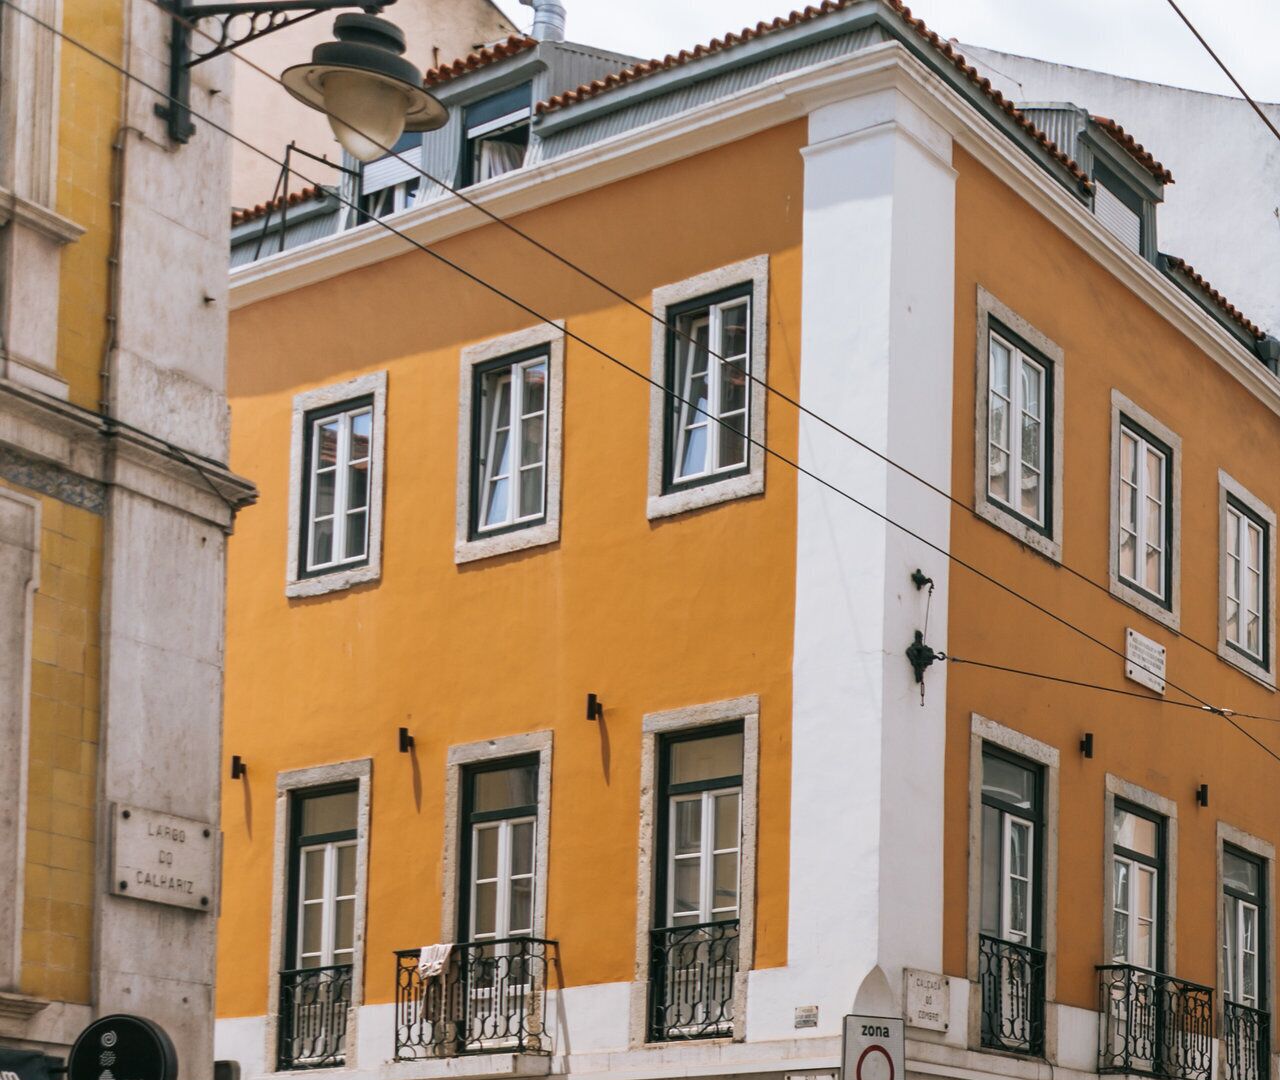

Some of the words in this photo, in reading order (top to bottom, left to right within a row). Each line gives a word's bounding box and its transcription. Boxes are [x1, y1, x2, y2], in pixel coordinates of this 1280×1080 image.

[147, 824, 186, 843] LARGO
[158, 850, 173, 866] DO
[136, 870, 195, 895] CALHARIZ
[861, 1024, 890, 1038] zona
